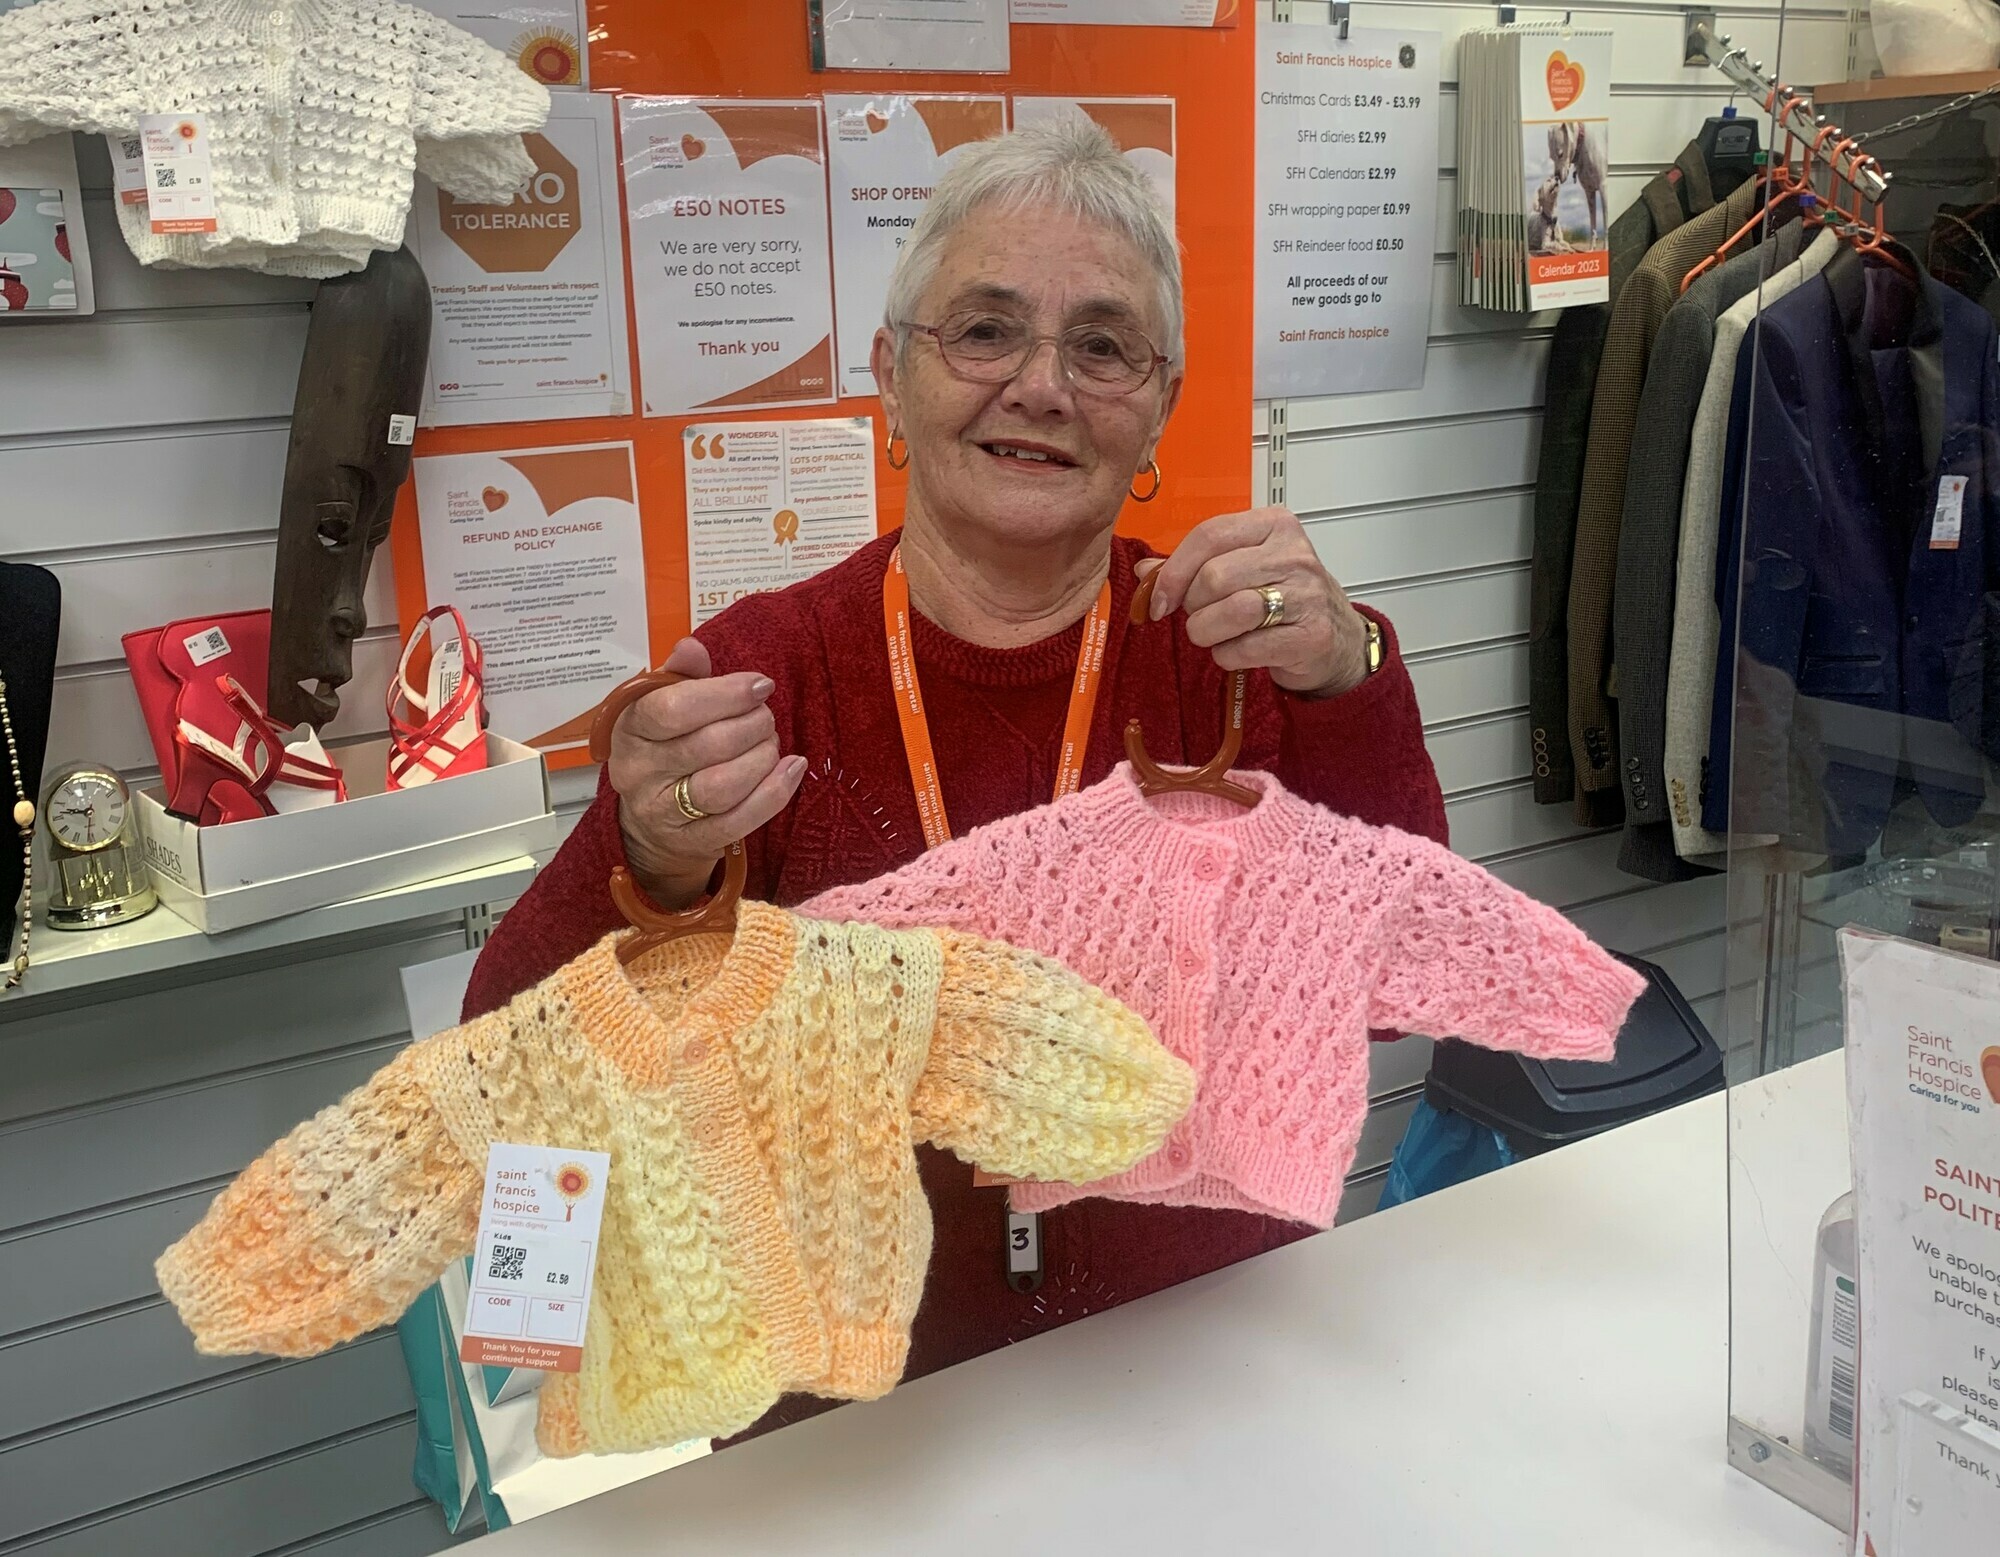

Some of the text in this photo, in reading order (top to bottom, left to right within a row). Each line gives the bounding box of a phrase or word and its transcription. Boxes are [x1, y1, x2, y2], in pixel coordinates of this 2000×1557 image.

[1276, 52, 1392, 70] Saint Francis Hospice
[1261, 92, 1316, 106] Christmas
[1319, 93, 1351, 106] Cards
[1354, 95, 1382, 107] £3.49
[1393, 97, 1420, 108] £3.99
[1297, 130, 1386, 144] SFH diaries £2.99
[1286, 167, 1396, 180] SFH Calendars £2.99
[851, 187, 936, 200] SHOP OPENI
[673, 198, 786, 217] £50 NOTES
[1268, 203, 1411, 218] SFH wrapping paper £0.99
[451, 212, 571, 231] TOLERANCE
[867, 216, 916, 229] Monday
[660, 239, 802, 255] We are very sorry,
[1273, 238, 1404, 253] SFH Reindeer food £0.50
[664, 259, 801, 276] we do not accept
[1539, 260, 1600, 278] Calendar 2023
[432, 286, 466, 295] Treating
[468, 284, 488, 293] Staff
[506, 284, 550, 292] Volunteers
[552, 282, 569, 290] with
[570, 282, 600, 291] respect
[694, 281, 776, 297] £50 notes.
[1287, 274, 1388, 290] All proceeds of our
[1292, 292, 1382, 307] new goods go to
[691, 319, 723, 328] apologise
[736, 318, 747, 326] any
[749, 316, 795, 325] inconvenience.
[1279, 326, 1389, 342] Saint Francis hospice
[698, 341, 780, 356] Thank you
[728, 431, 779, 439] WONDERFUL
[791, 456, 810, 464] LOTS
[824, 453, 865, 461] PRACTICAL
[791, 466, 827, 475] SUPPORT
[462, 522, 603, 544] REFUND AND EXCHANGE
[514, 539, 555, 551] POLICY
[698, 591, 728, 606] 1ST
[899, 630, 907, 656] francis
[1078, 615, 1098, 694] saint francis hospice
[903, 657, 914, 690] hospice
[908, 689, 920, 714] retail
[1064, 742, 1074, 764] retail
[923, 762, 939, 814] saint francis
[147, 836, 182, 874] SHADES
[1907, 1025, 1952, 1053] Saint
[1908, 1045, 1974, 1078] Francis
[1908, 1064, 1982, 1100] Hospice
[1909, 1083, 1980, 1114] Caring for you
[496, 1169, 528, 1182] saint
[495, 1183, 537, 1197] francis
[493, 1198, 540, 1214] hospice
[509, 1219, 524, 1228] with
[525, 1221, 548, 1231] dignity
[493, 1233, 512, 1241] Kids
[1011, 1227, 1029, 1251] 3
[1912, 1235, 1940, 1259] We
[546, 1272, 569, 1285] £2.50
[1928, 1266, 1987, 1300] unable
[488, 1297, 511, 1307] CODE
[548, 1302, 565, 1312] SIZE
[482, 1342, 561, 1358] Thank You for your
[1974, 1345, 1986, 1361] If
[481, 1353, 558, 1368] continued support
[1942, 1376, 1998, 1410] please
[1936, 1440, 1990, 1480] Thank
